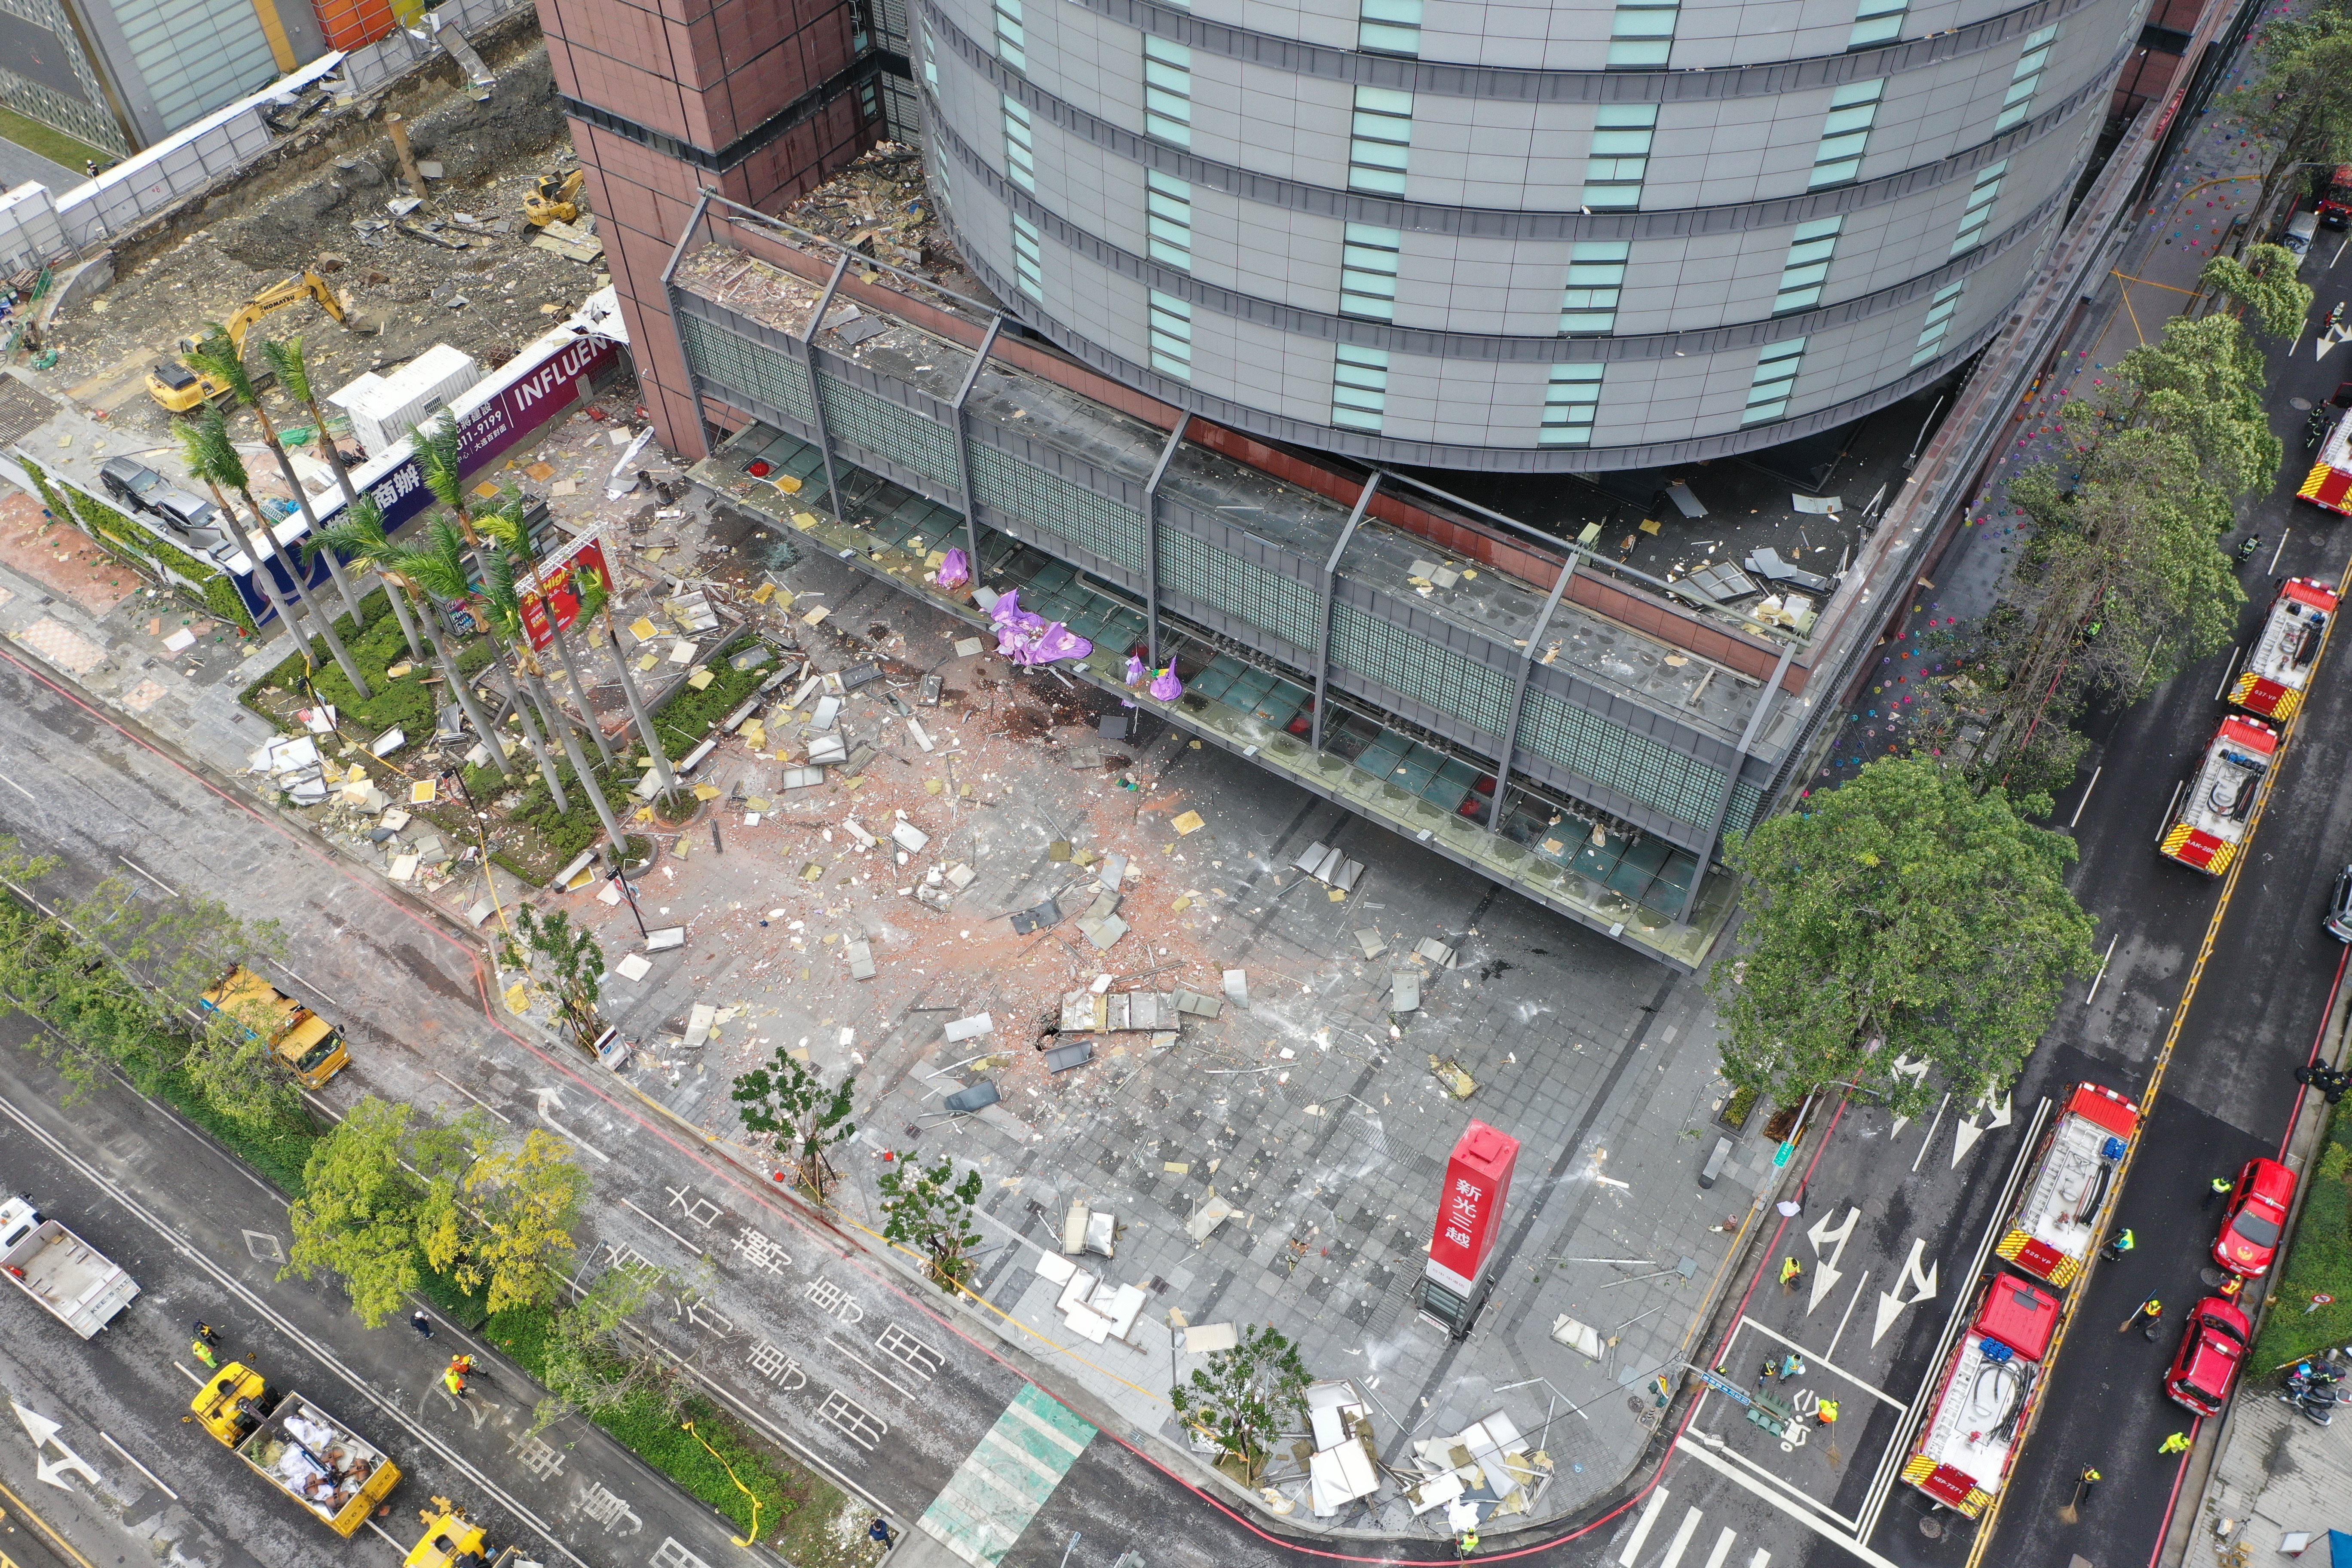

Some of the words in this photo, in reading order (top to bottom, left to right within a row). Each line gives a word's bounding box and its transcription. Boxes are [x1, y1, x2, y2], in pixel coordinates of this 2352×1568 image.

[263, 295, 295, 311] KOMATSU
[514, 333, 614, 411] INFLUEN
[1445, 1178, 1482, 1249] 新光三越
[665, 1185, 947, 1381] 右轉專用
[604, 1241, 888, 1451] 直行專用
[1933, 1475, 1963, 1494] KEP-7271
